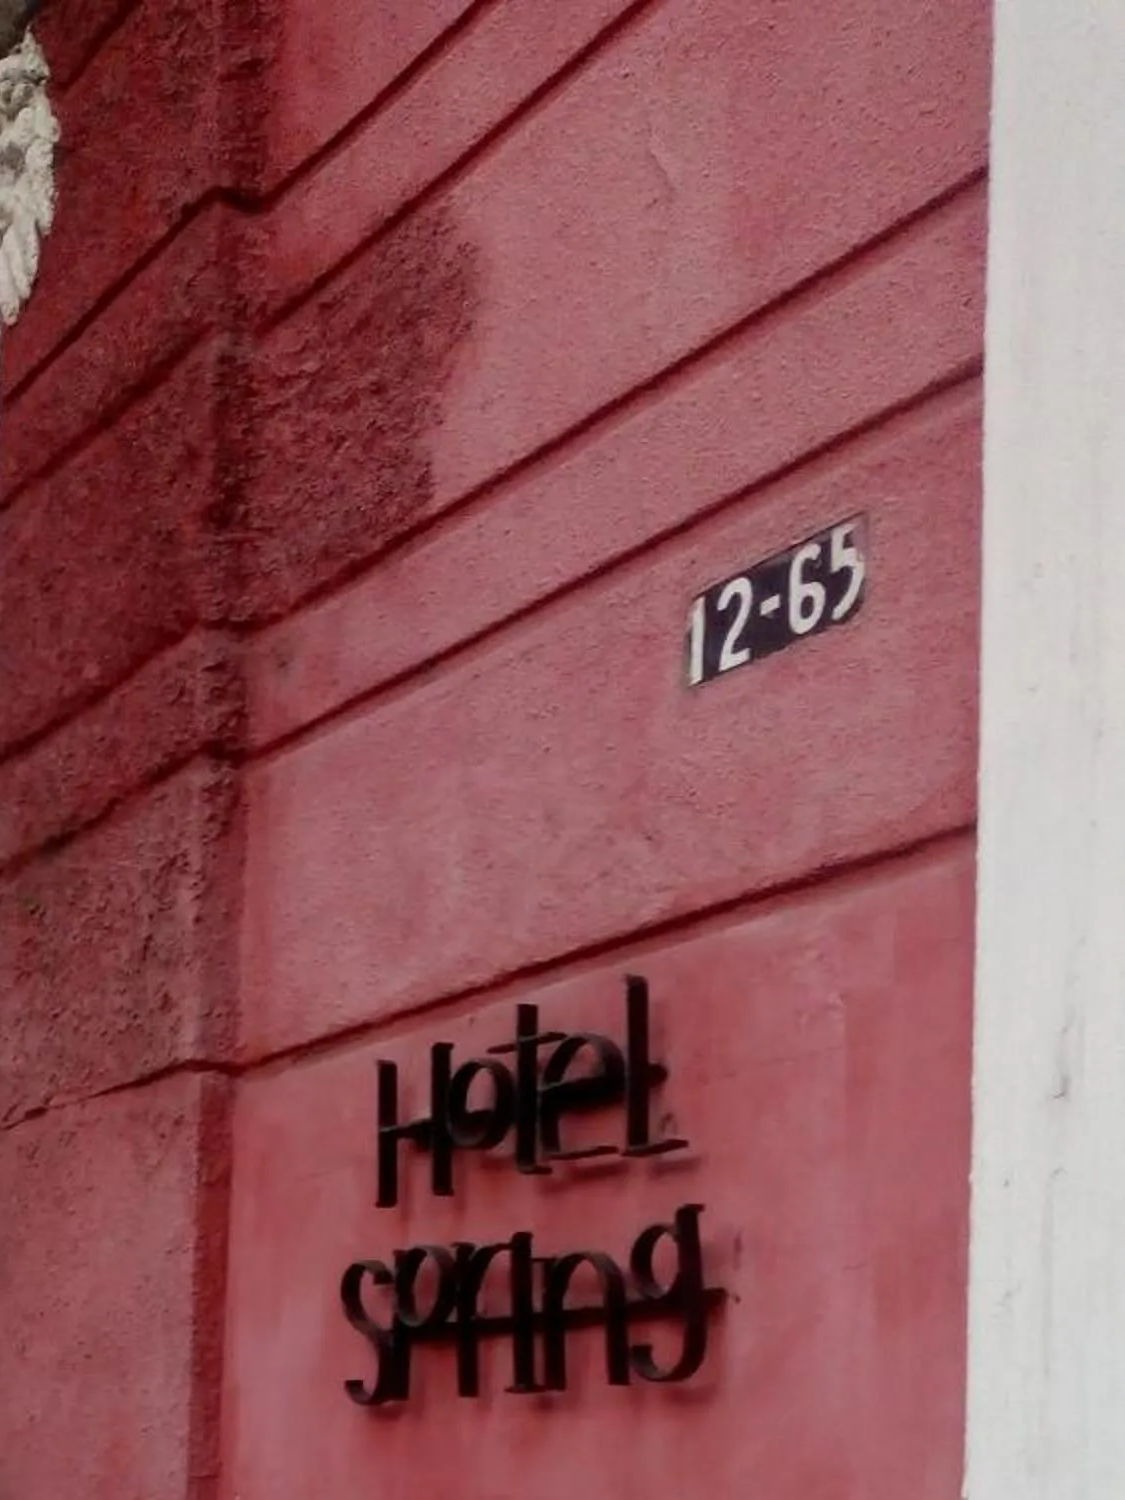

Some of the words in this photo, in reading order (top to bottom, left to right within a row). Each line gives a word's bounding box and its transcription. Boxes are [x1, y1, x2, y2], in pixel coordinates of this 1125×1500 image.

[688, 521, 866, 687] 12-65
[376, 975, 689, 1208] Hotel
[340, 1203, 727, 1406] Spring
